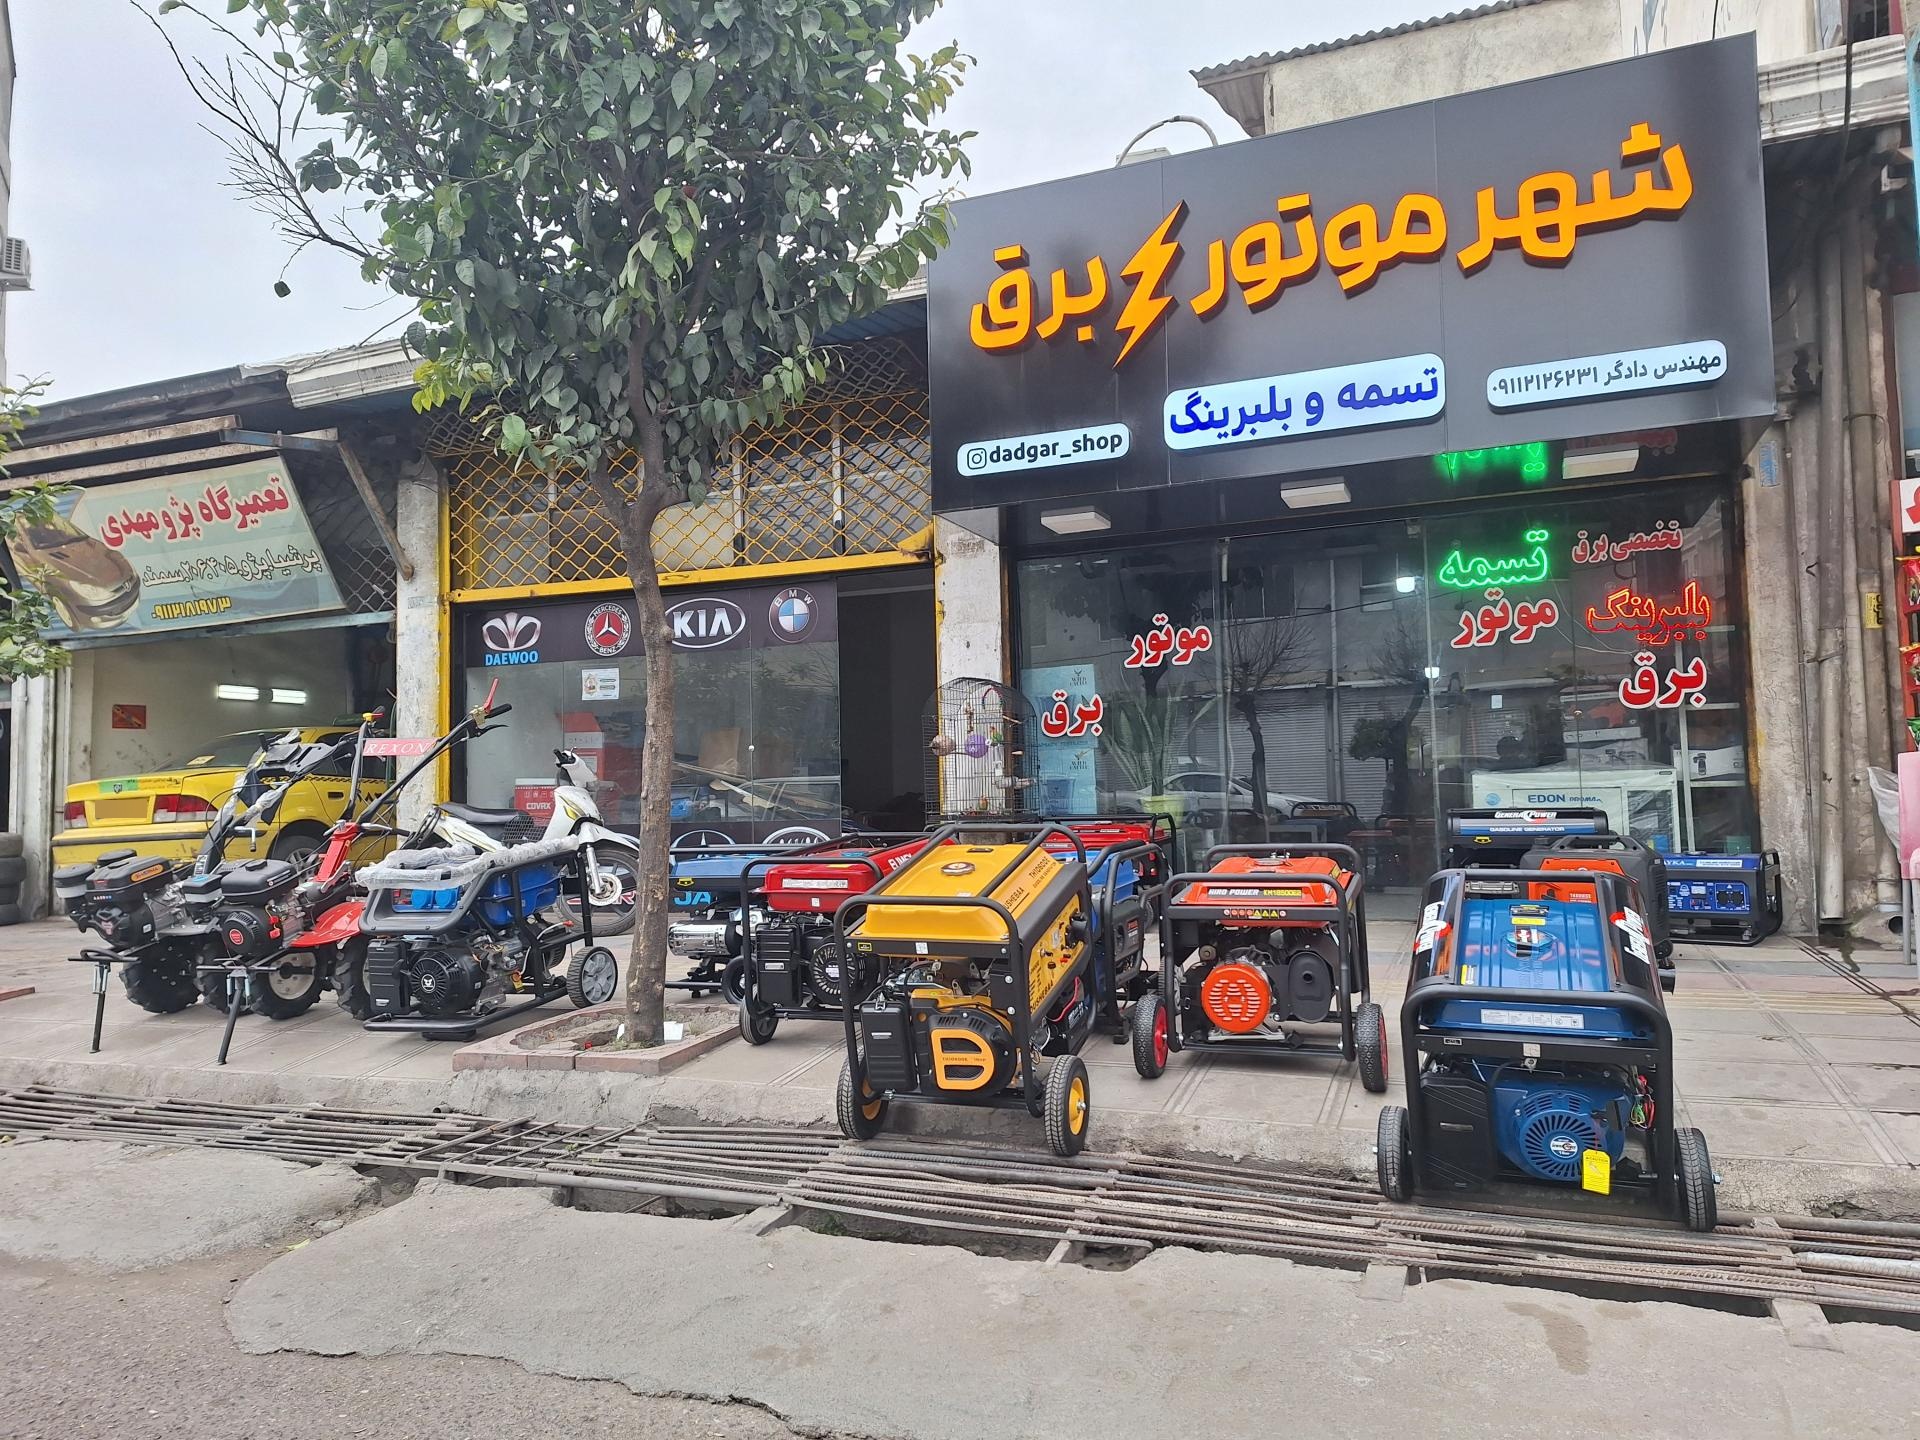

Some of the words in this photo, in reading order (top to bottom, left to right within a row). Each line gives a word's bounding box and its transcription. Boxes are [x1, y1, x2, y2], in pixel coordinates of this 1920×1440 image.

[1456, 120, 1694, 271] شهر
[1190, 192, 1448, 315] موتور
[969, 244, 1109, 350] برق
[1337, 366, 1438, 410] تسمه
[1604, 360, 1648, 386] دادگر
[1653, 353, 1722, 380] مهندس
[1169, 385, 1293, 438] بلبرینگ
[1304, 390, 1325, 427] و
[989, 431, 1123, 465] dadgar_shop
[162, 496, 202, 540] پژو
[198, 477, 290, 528] تعمیرگاه
[101, 508, 160, 547] مهدی
[1571, 529, 1609, 565] برق
[1609, 520, 1683, 560] تخصصی
[1437, 528, 1550, 589] تسمه
[593, 604, 622, 616] MERCEDES
[774, 589, 814, 608] BMW
[1449, 587, 1560, 650] موتور
[1586, 579, 1713, 646] بلبرینگ
[672, 607, 733, 639] KIA
[1124, 614, 1213, 668] موتور
[485, 650, 540, 666] DAEWOO
[1617, 651, 1708, 710] برق
[1041, 688, 1104, 738] برق
[1527, 794, 1566, 803] EDON
